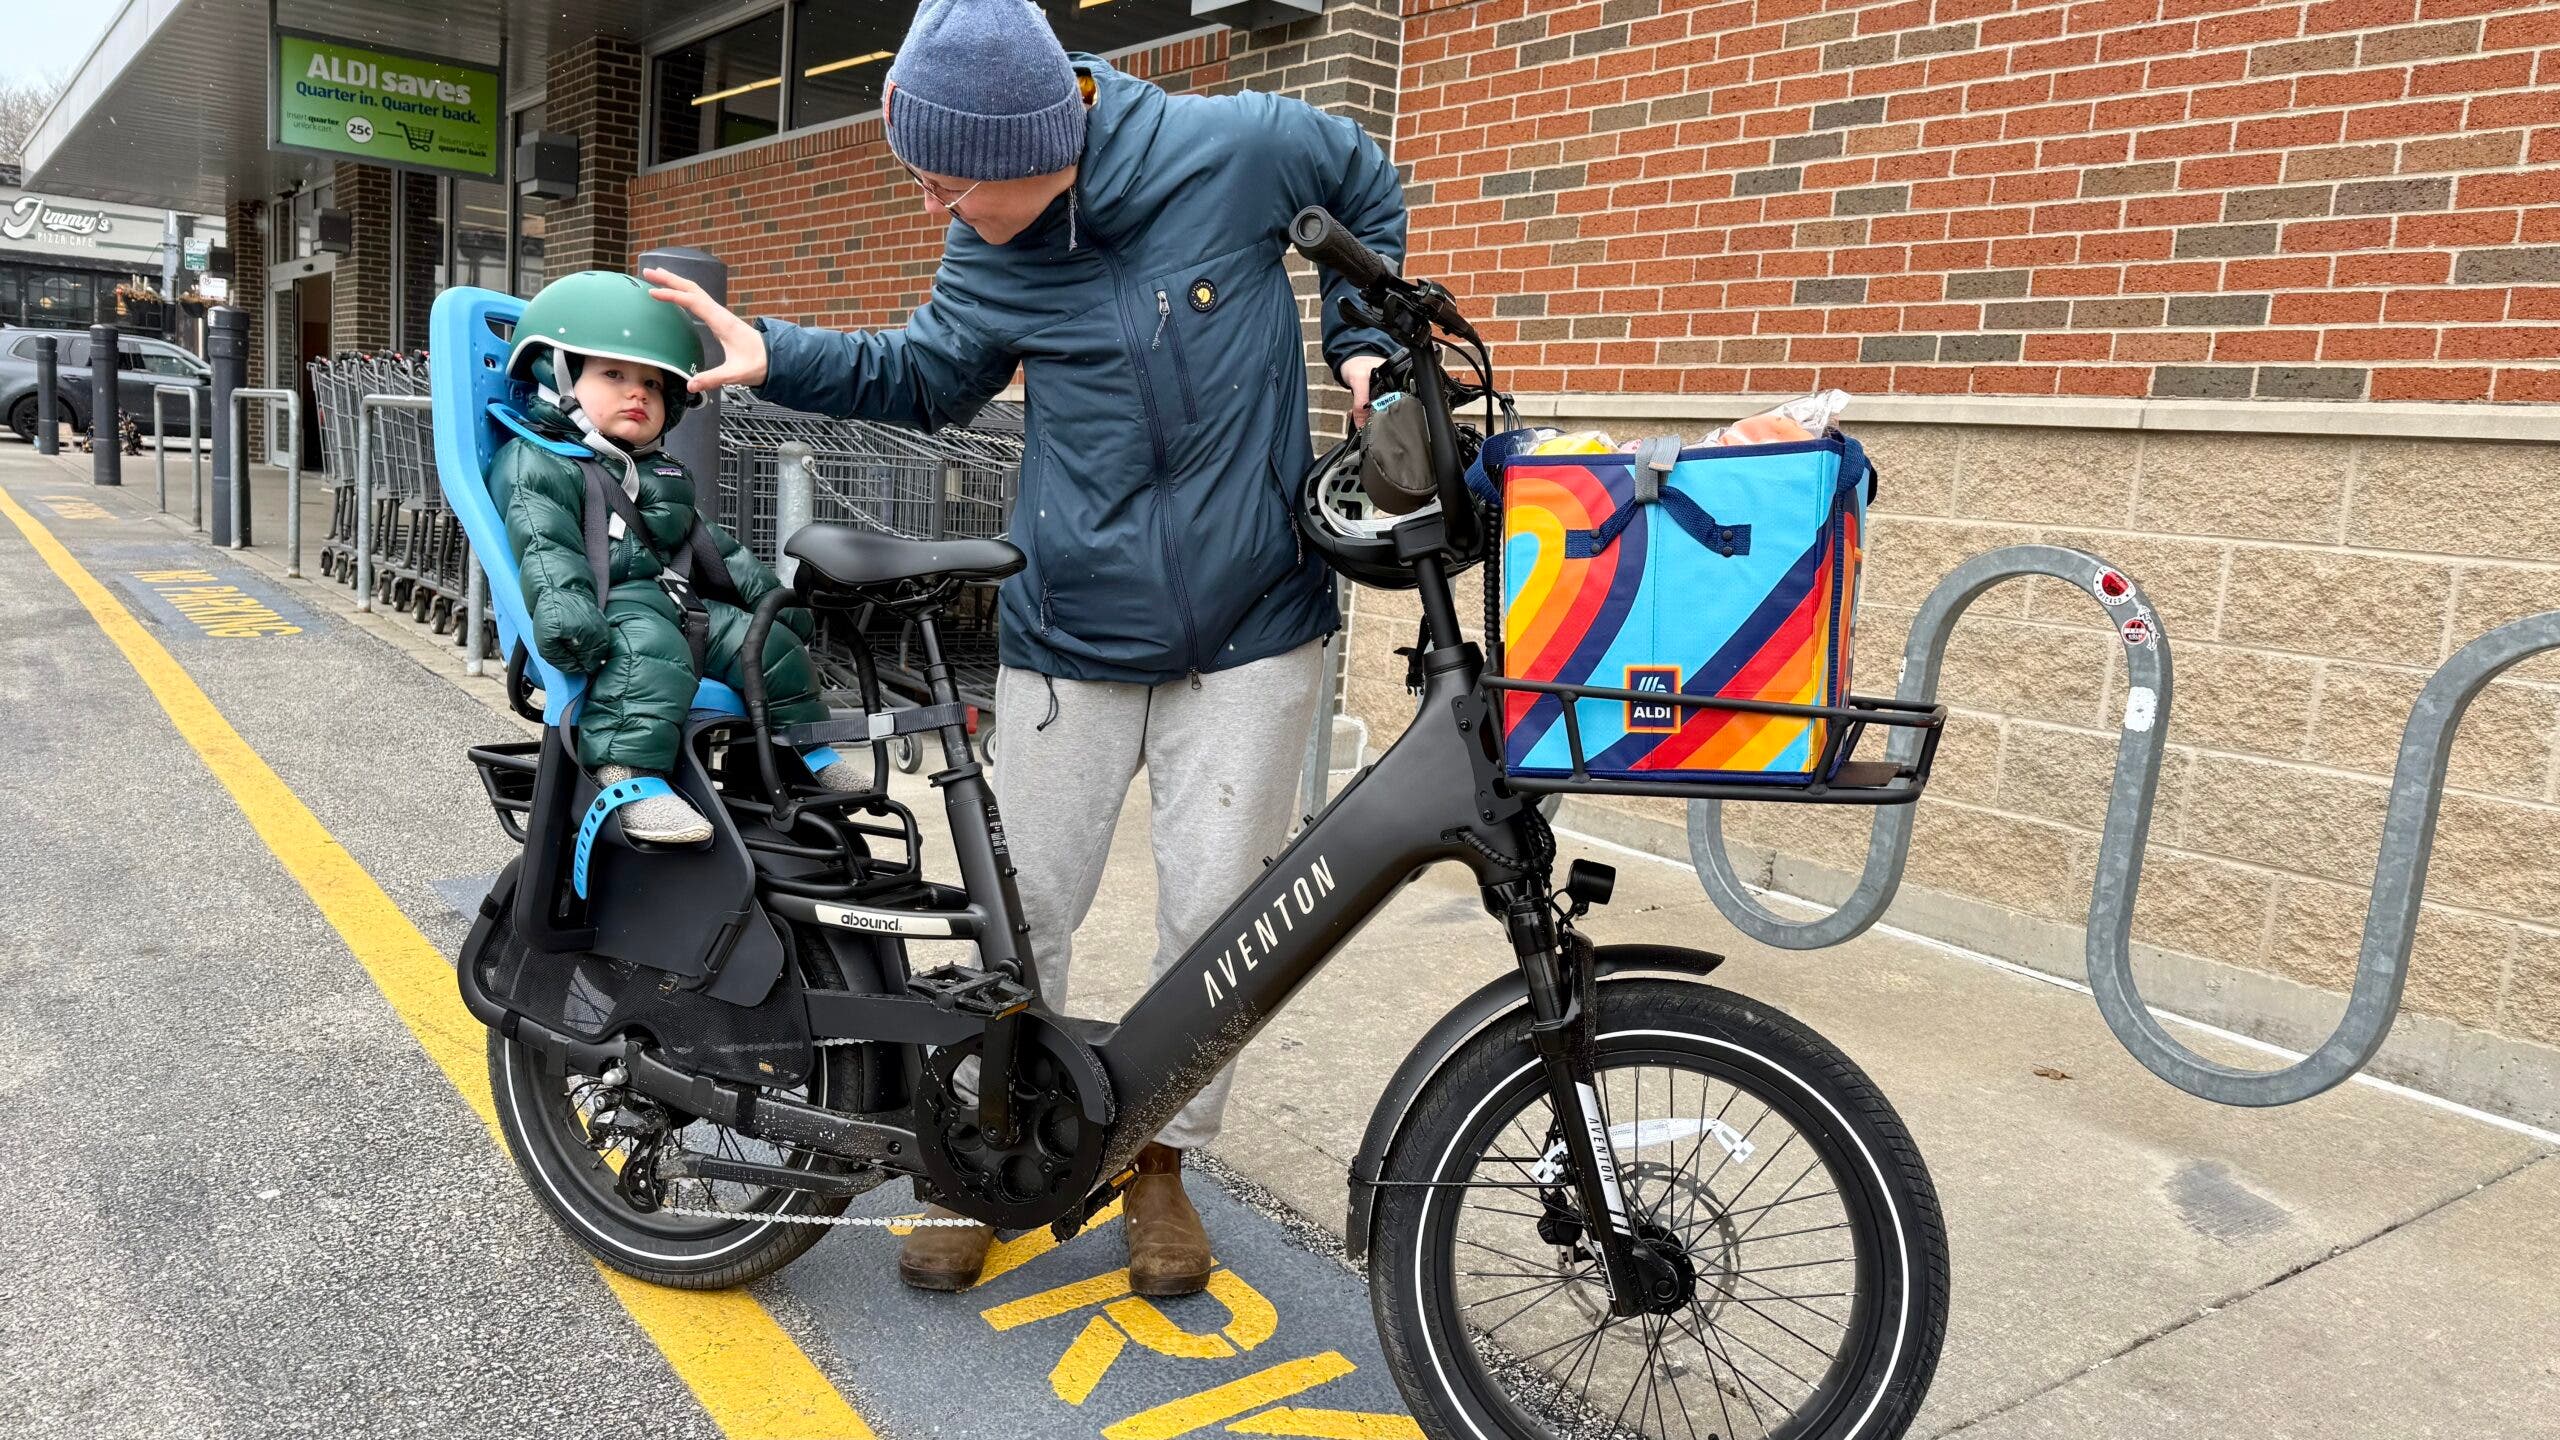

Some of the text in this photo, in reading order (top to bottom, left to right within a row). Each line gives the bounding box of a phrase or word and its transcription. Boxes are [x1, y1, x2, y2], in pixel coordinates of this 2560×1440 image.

[307, 53, 471, 105] ALDI saves
[296, 81, 480, 124] Quarter in. Quarter back.
[308, 115, 340, 126] quarter
[2, 196, 112, 239] Jimmy's
[37, 231, 93, 248] PIZZA CAFE
[129, 569, 303, 638] NO PARKING
[1633, 706, 1671, 719] ALDI
[841, 912, 899, 931] abound
[1203, 854, 1336, 1009] AVENTON
[1588, 1117, 1615, 1183] AVENTON
